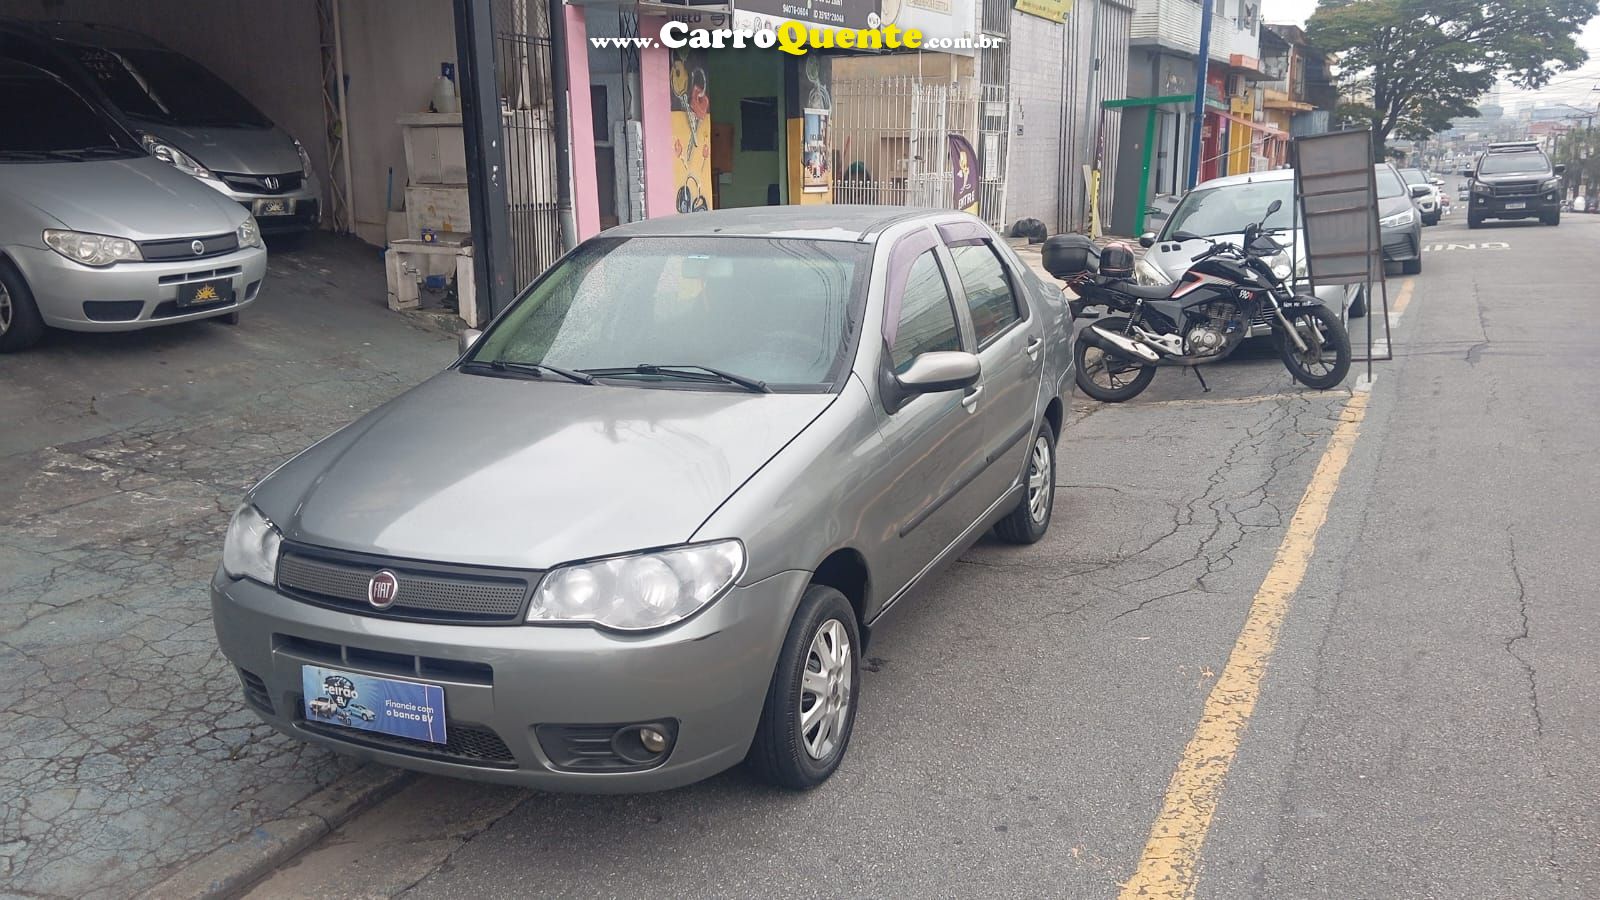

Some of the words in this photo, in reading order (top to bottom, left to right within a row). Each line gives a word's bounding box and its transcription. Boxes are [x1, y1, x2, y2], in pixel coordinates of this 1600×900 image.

[373, 581, 392, 599] FIAT
[322, 684, 358, 699] Feirão
[385, 699, 416, 711] Financie
[417, 705, 434, 713] com
[393, 709, 420, 720] banco
